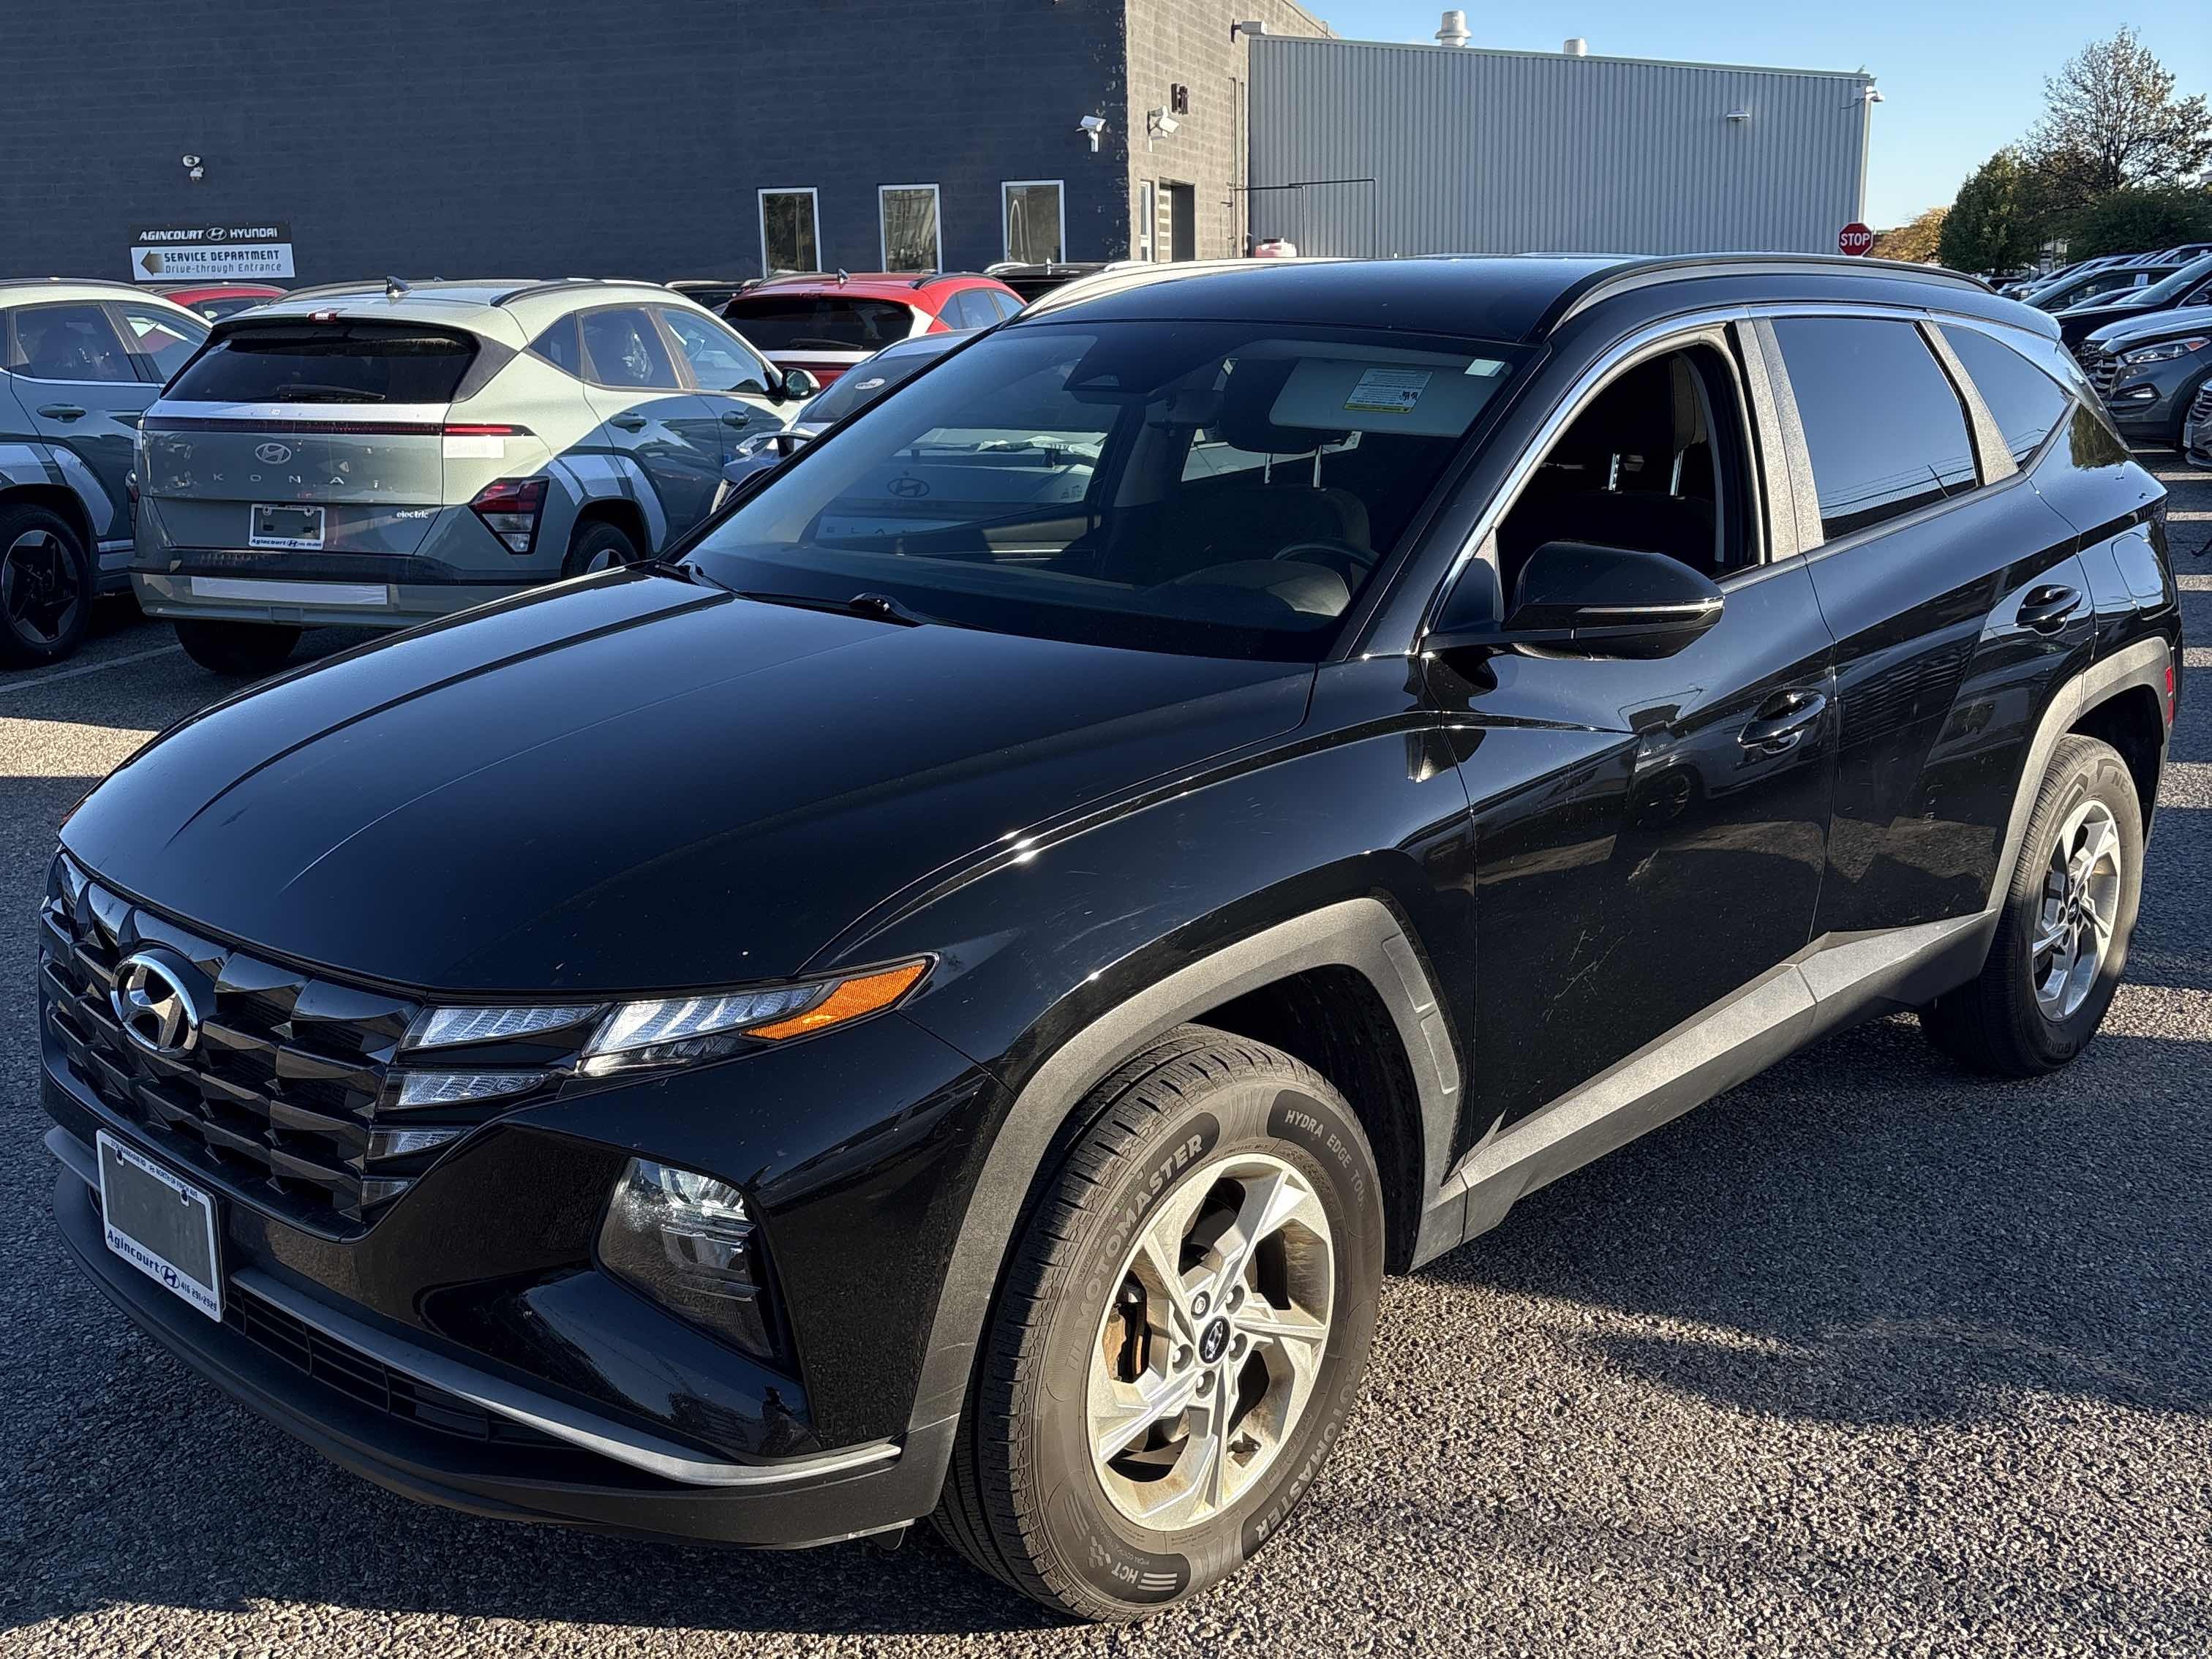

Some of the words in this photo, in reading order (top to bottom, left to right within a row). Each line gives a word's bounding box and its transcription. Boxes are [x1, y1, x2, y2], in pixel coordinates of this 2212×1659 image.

[138, 230, 205, 241] AGINCOURT
[230, 227, 278, 240] HYUNDAI
[1840, 233, 1870, 247] STOP
[165, 252, 208, 263] SERVICE
[211, 249, 280, 262] DEPARTMENT
[165, 263, 234, 274] Drive-through
[238, 263, 282, 272] Entrance
[213, 473, 345, 485] KONA
[396, 510, 429, 519] electric
[1284, 1109, 1325, 1139] HYDRA
[1326, 1133, 1353, 1169] EDGE
[107, 1230, 160, 1274] Agincourt
[1111, 1562, 1140, 1584] HCT
